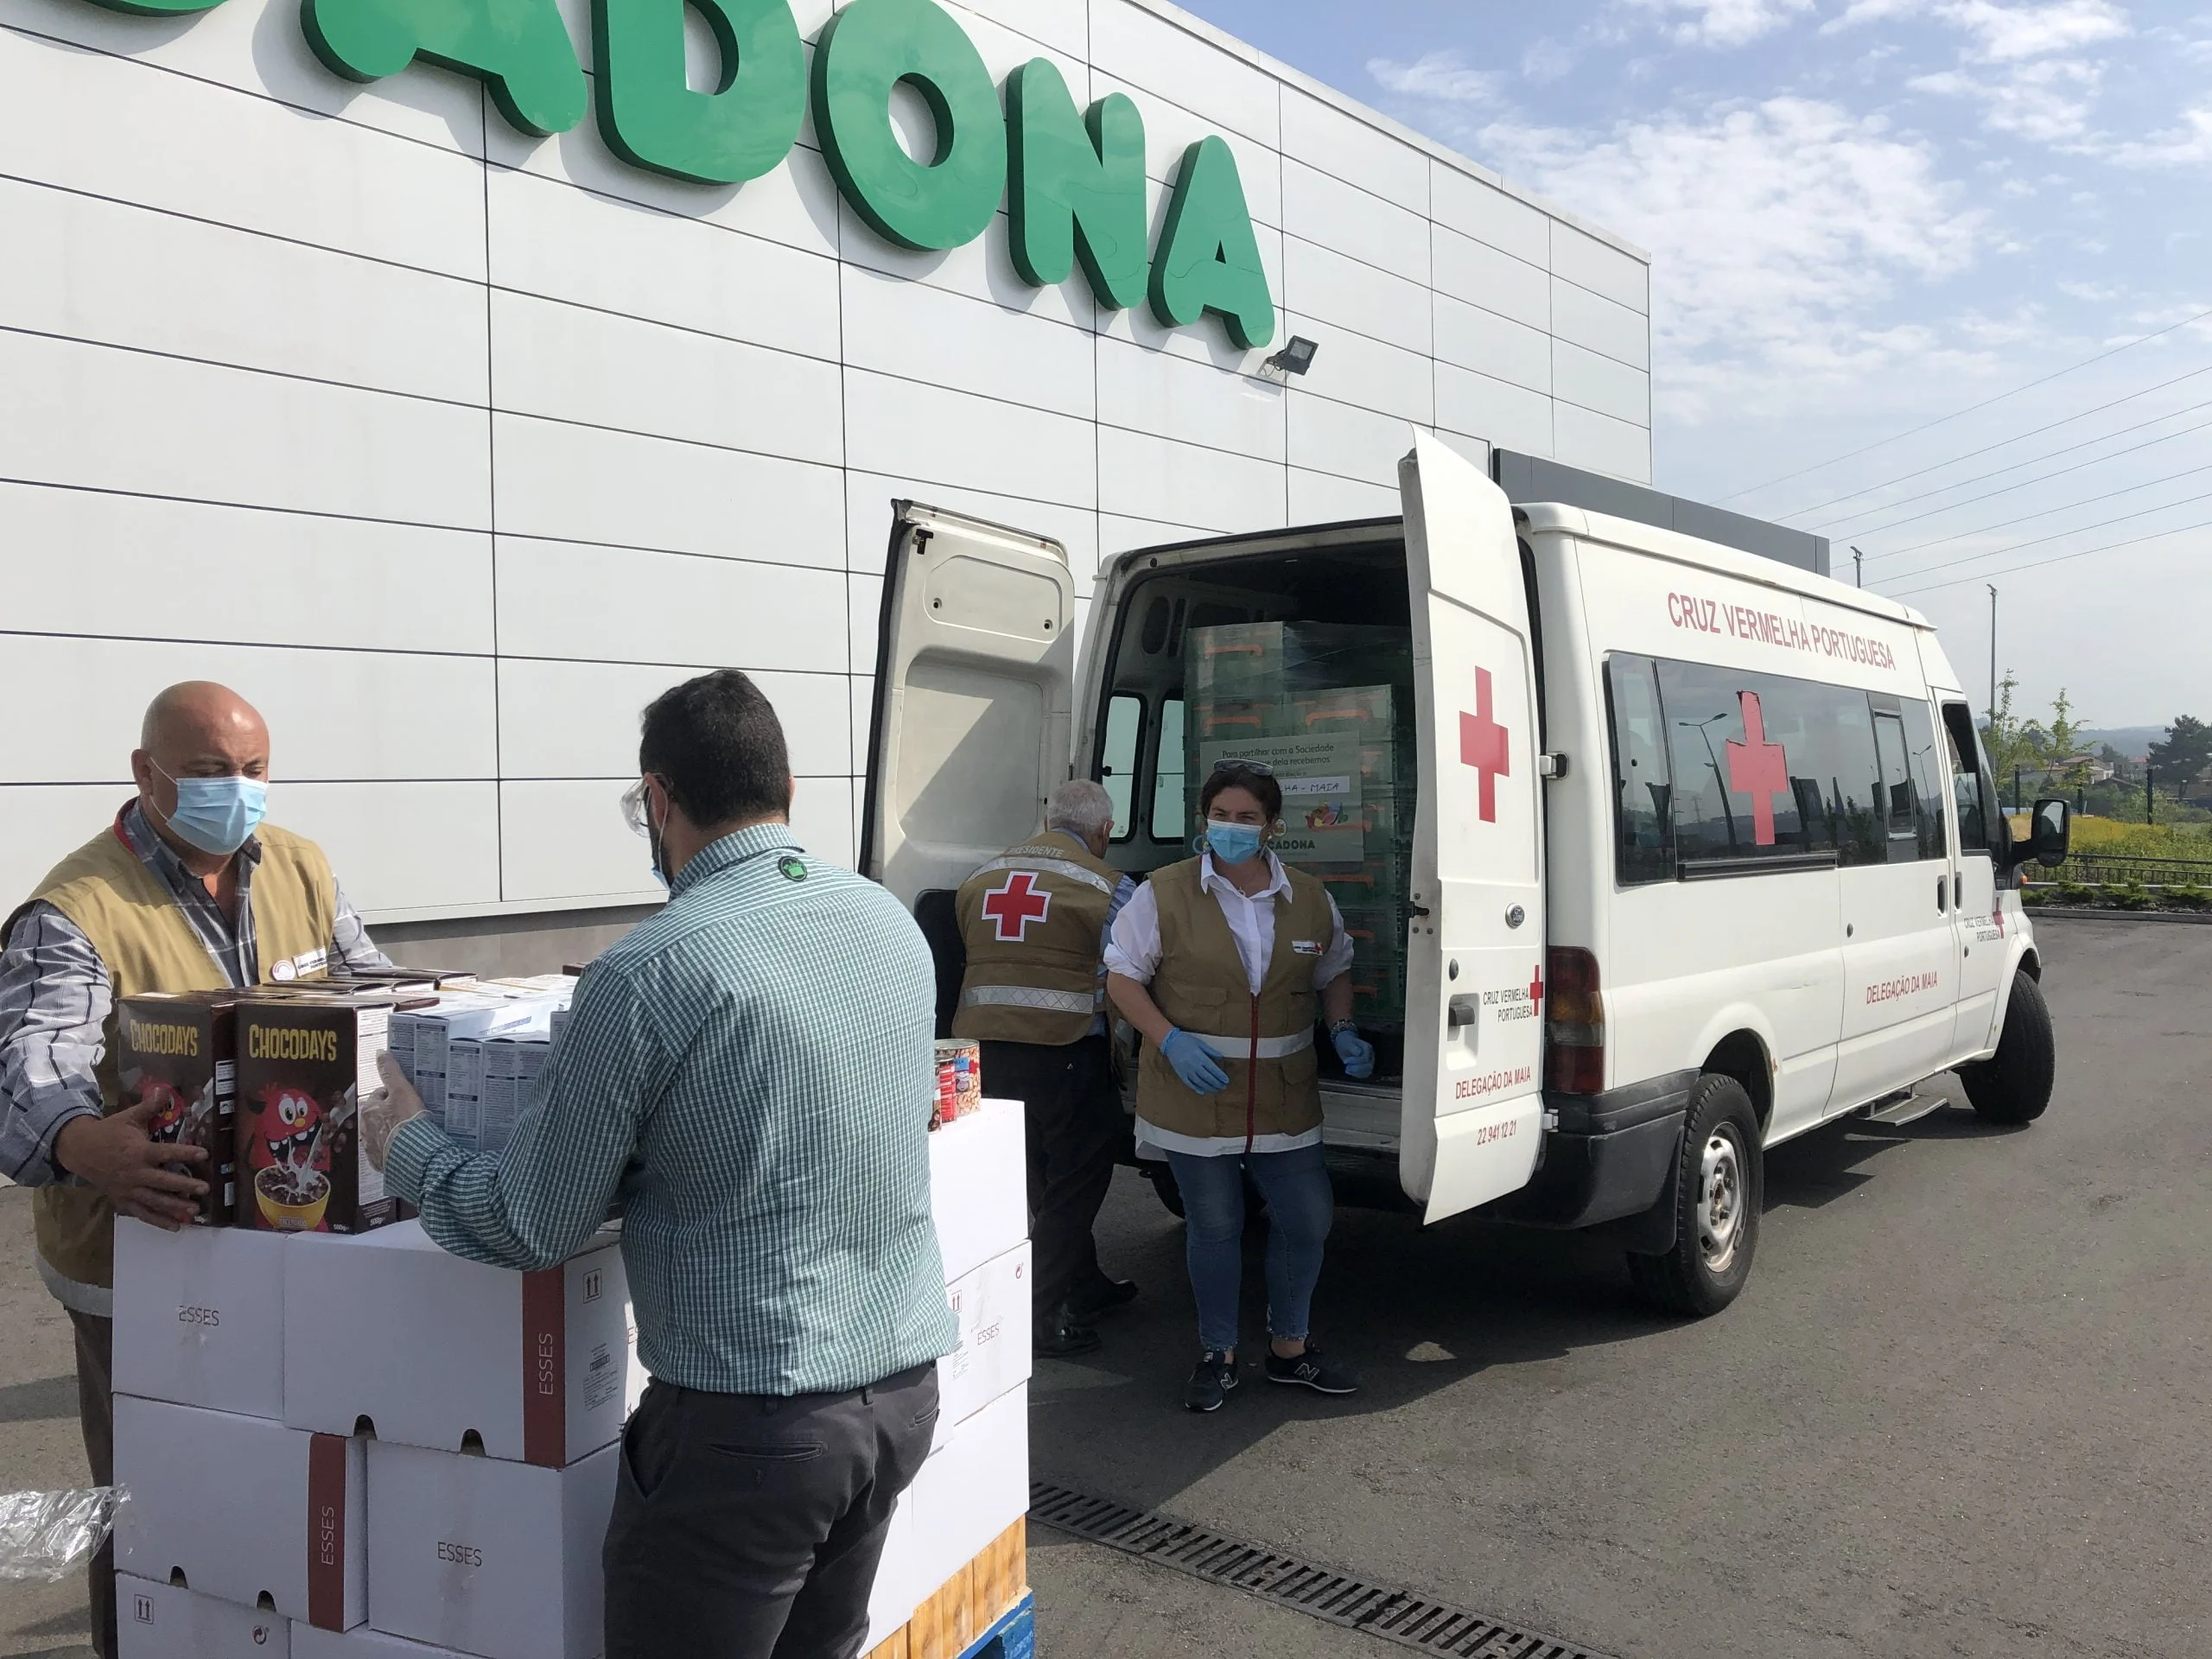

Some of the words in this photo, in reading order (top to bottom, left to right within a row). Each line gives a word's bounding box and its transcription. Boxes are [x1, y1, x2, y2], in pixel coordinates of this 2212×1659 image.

[73, 0, 1276, 350] DONA
[1668, 592, 1721, 634] CRUZ
[1722, 603, 1812, 652] VERMELHA
[1810, 624, 1897, 671] PORTUGUESA
[1222, 750, 1238, 759] Para
[1239, 748, 1269, 759] partilhar
[1271, 747, 1287, 756] com
[1295, 743, 1334, 753] Sociedade
[1272, 758, 1289, 766] dela
[1290, 756, 1331, 765] recebemos
[1008, 845, 1065, 857] PRESIDENTE
[1483, 990, 1499, 1005] CRUZ
[1501, 987, 1529, 1003] VERMELHA
[1866, 975, 1910, 1005] DELEGAÇÃO
[1910, 975, 1920, 993] DA
[1922, 970, 1938, 990] MAIA
[1497, 1005, 1533, 1022] PORTUGUESA
[130, 1019, 199, 1058] CHOCODAYS
[249, 1023, 337, 1062] CHOCODAYS
[1455, 1071, 1502, 1099] DELEGAÇÃO
[1503, 1071, 1513, 1089] DA
[1515, 1066, 1531, 1085] MAIA
[1477, 1127, 1487, 1146] 22
[1488, 1123, 1500, 1143] 941
[1501, 1122, 1509, 1139] 12
[1509, 1120, 1517, 1137] 21
[179, 1305, 219, 1326] ESSES
[977, 1322, 1000, 1345] ESSES
[538, 1332, 554, 1395] ESSES
[321, 1505, 334, 1566] ESSES
[437, 1541, 482, 1567] ESSES
